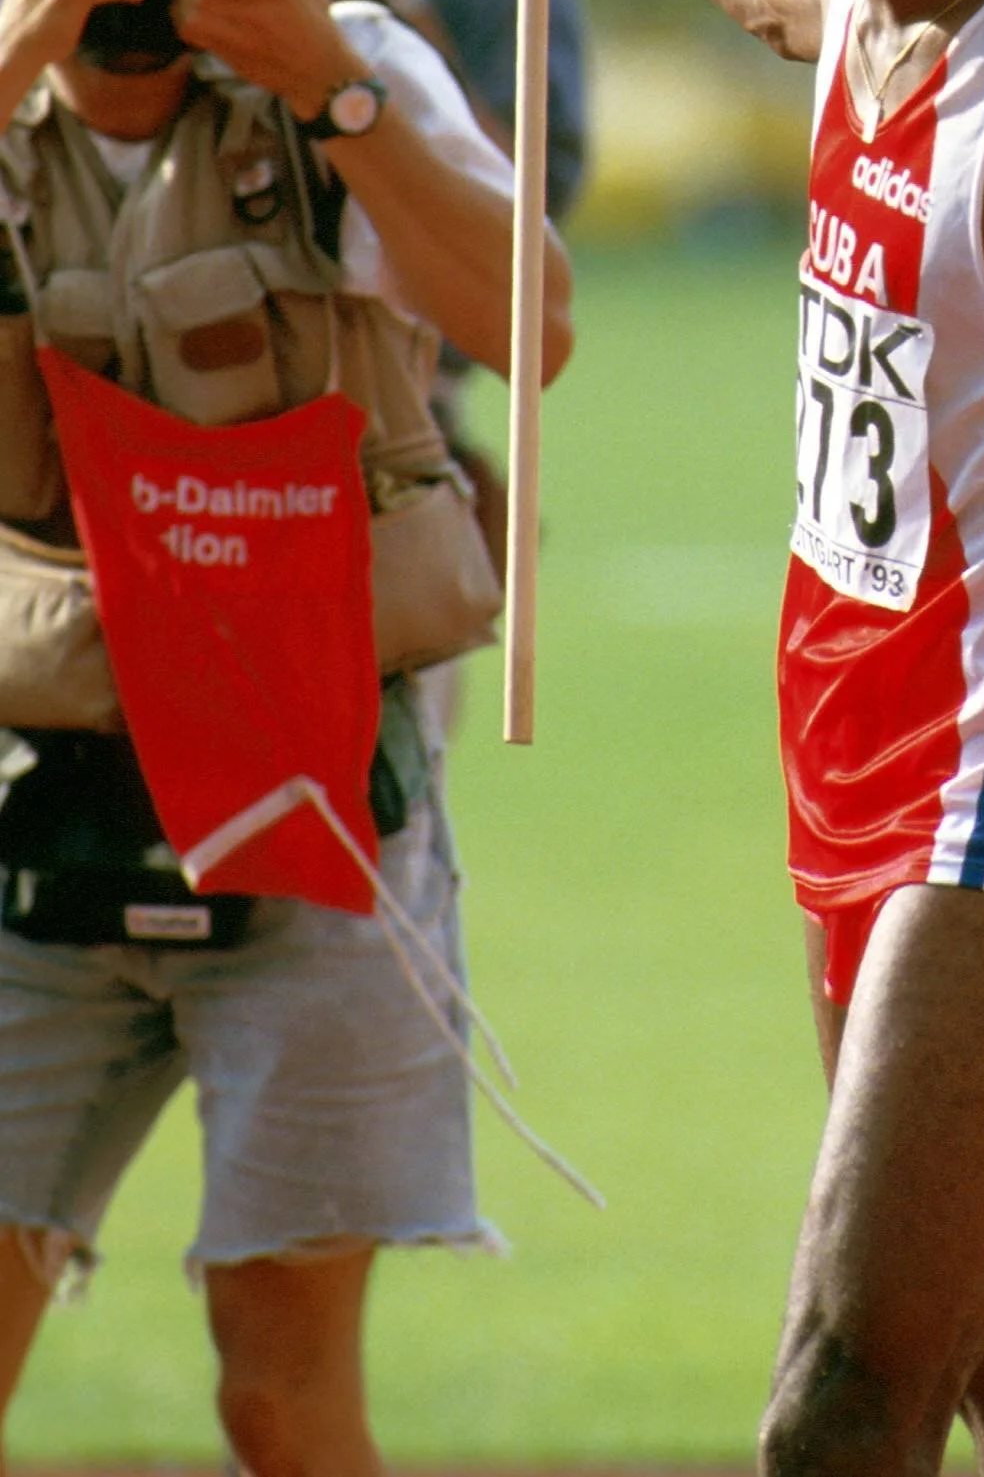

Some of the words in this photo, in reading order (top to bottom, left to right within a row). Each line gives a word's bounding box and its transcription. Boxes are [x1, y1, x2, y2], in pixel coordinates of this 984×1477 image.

[852, 155, 935, 224] adidas
[800, 283, 922, 401] TDK
[798, 371, 896, 549] 13
[864, 562, 904, 597] '93
